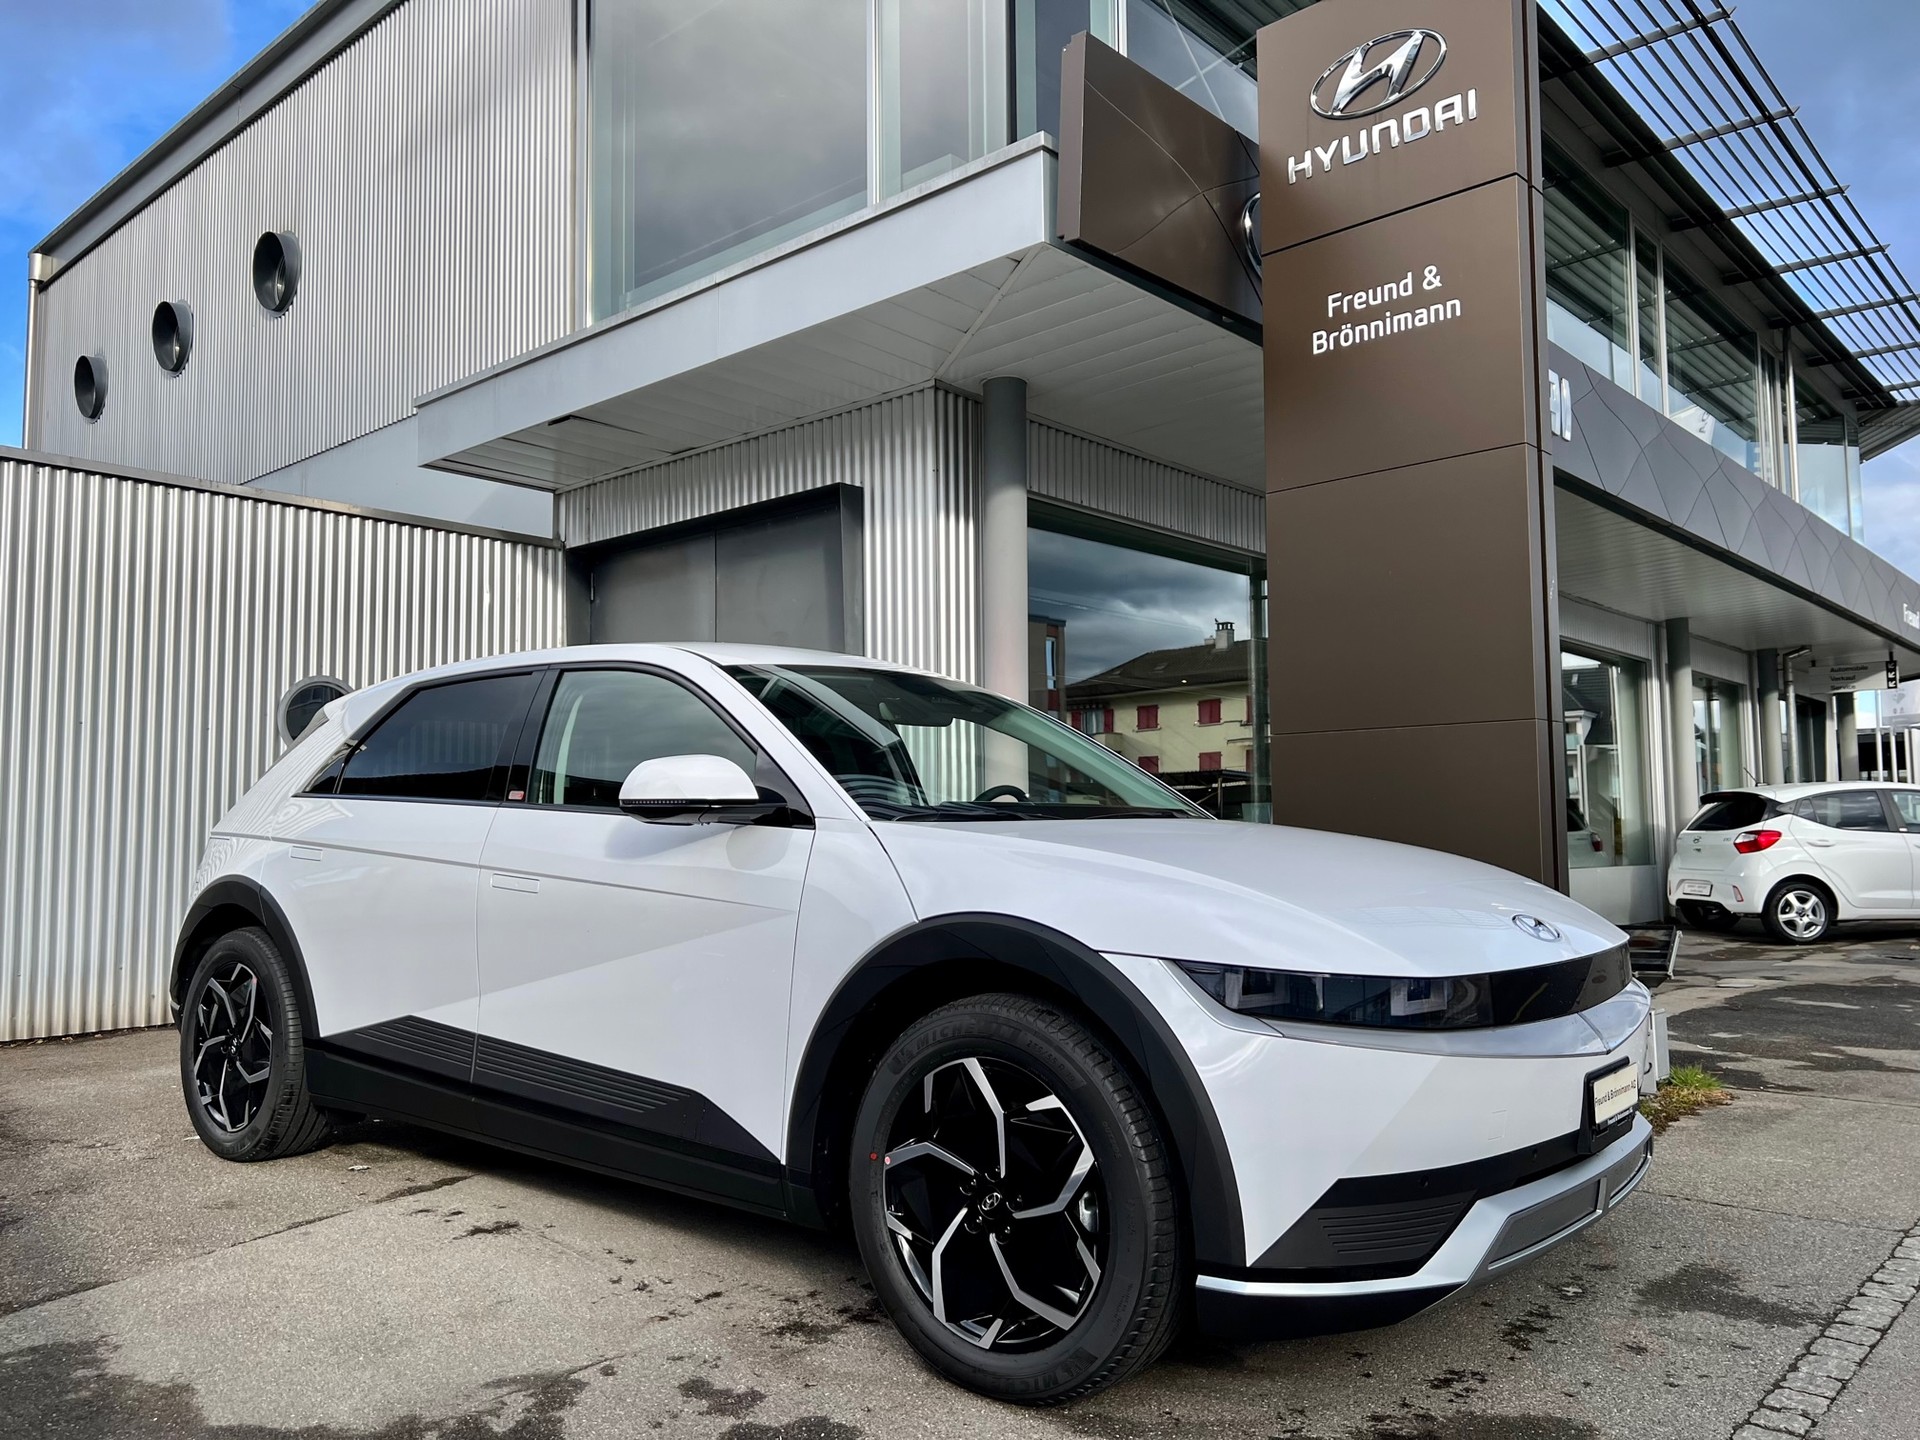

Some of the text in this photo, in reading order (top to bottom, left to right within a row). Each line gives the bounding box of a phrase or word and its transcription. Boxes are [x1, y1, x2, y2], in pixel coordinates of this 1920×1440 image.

[1286, 87, 1478, 184] HYUNDAI
[1327, 264, 1443, 318] Freund &
[1311, 298, 1461, 356] Brönnimann
[1830, 665, 1868, 673] Automobile
[916, 1021, 1021, 1050] MICHEI
[1595, 1094, 1607, 1106] Freund
